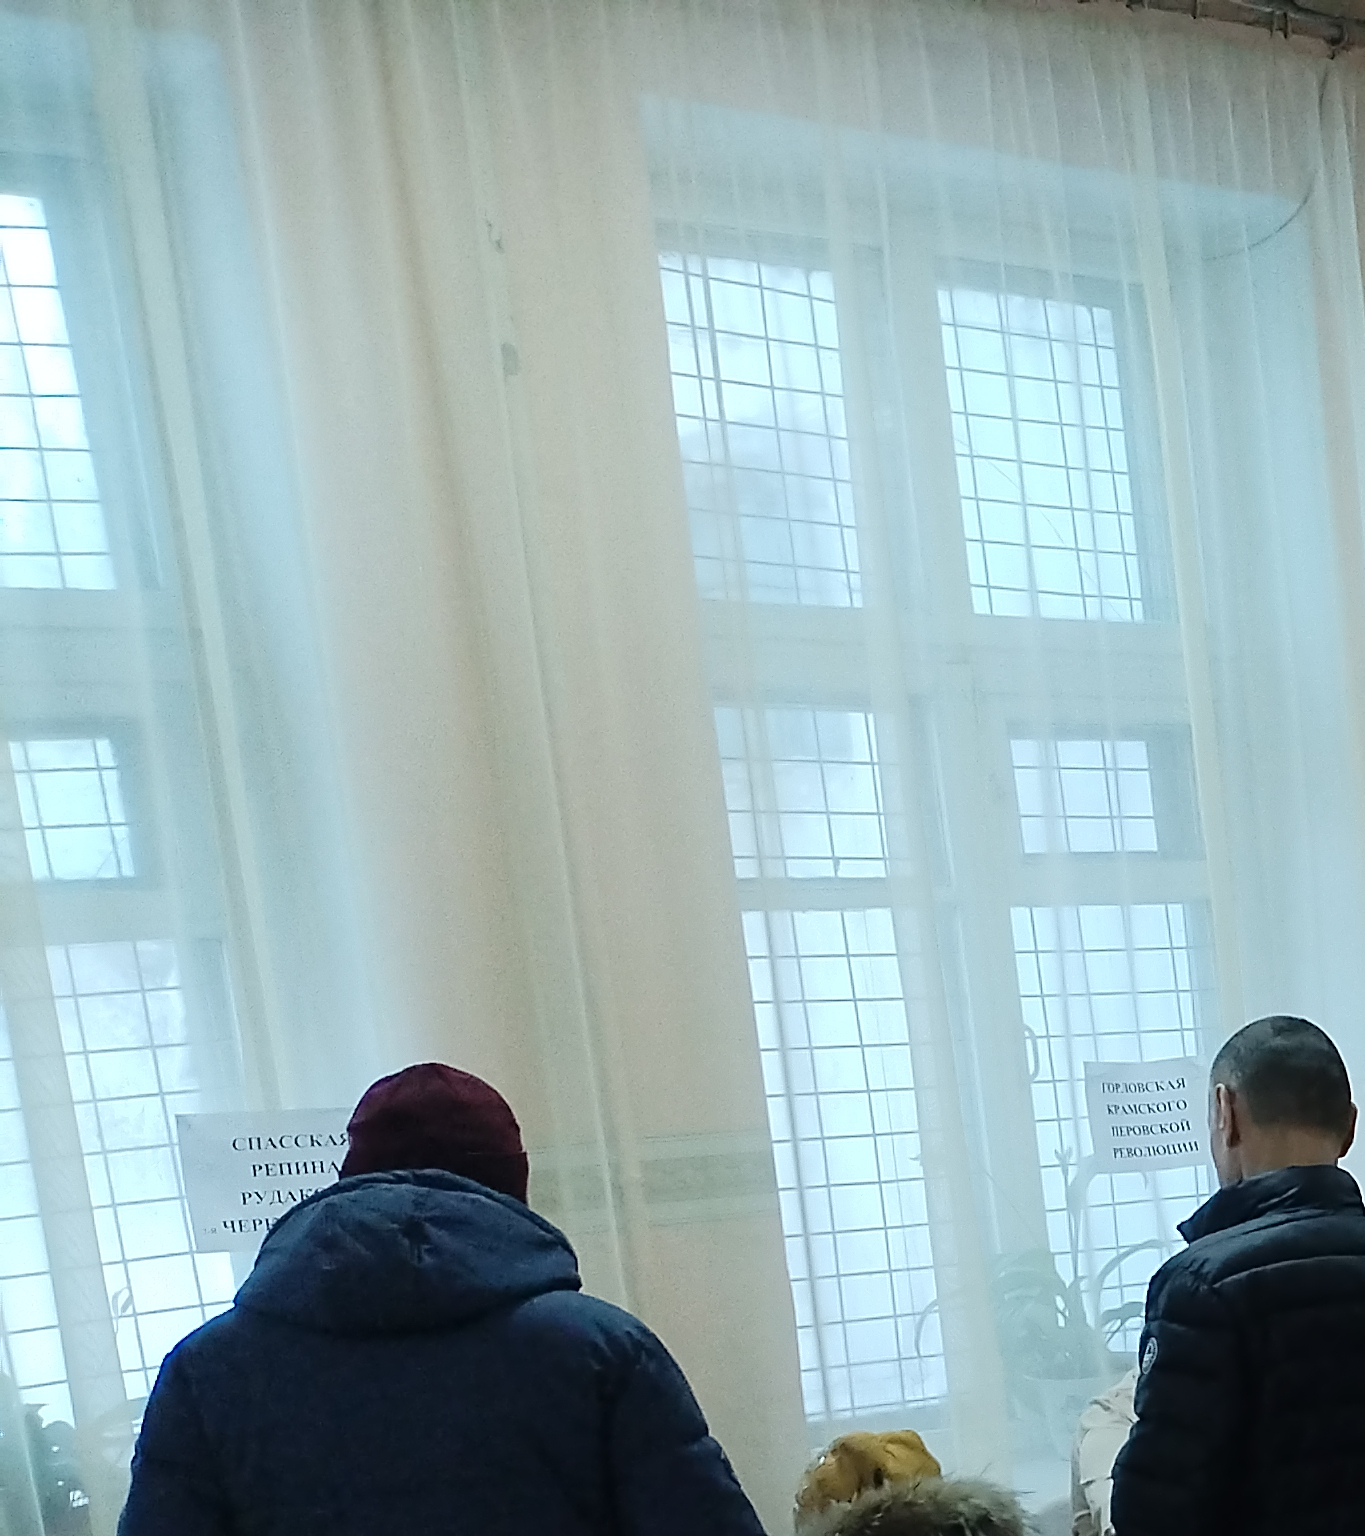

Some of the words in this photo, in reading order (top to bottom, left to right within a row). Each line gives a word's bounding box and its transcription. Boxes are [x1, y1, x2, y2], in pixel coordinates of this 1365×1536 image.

[1101, 1077, 1187, 1094] ГОРЛОВСКАЯ
[1106, 1099, 1189, 1115] КРАМСКОГО
[1111, 1119, 1192, 1137] ПЕРОВСКОЙ
[231, 1132, 350, 1152] СПАССКАЯ
[1112, 1140, 1200, 1159] РЕВОЛЮЦИИ
[251, 1160, 341, 1178] РЕПИНА
